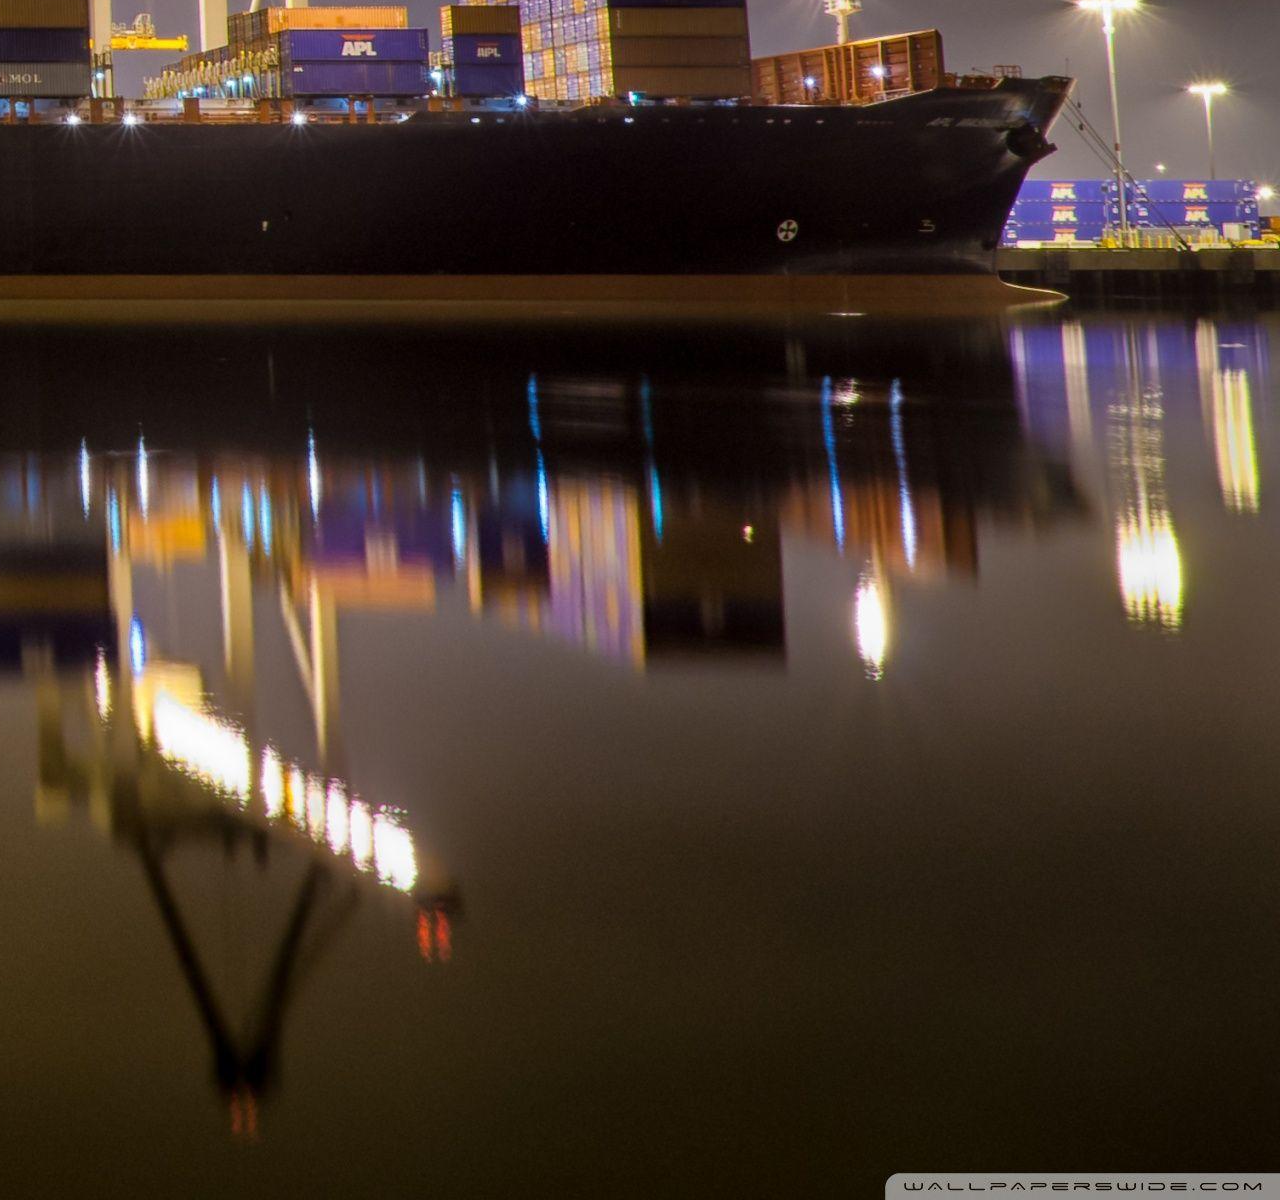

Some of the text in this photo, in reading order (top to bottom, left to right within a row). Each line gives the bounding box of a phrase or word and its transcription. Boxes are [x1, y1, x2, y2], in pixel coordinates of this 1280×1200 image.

[342, 41, 377, 56] APL
[477, 47, 501, 57] APL
[9, 74, 42, 84] MOL
